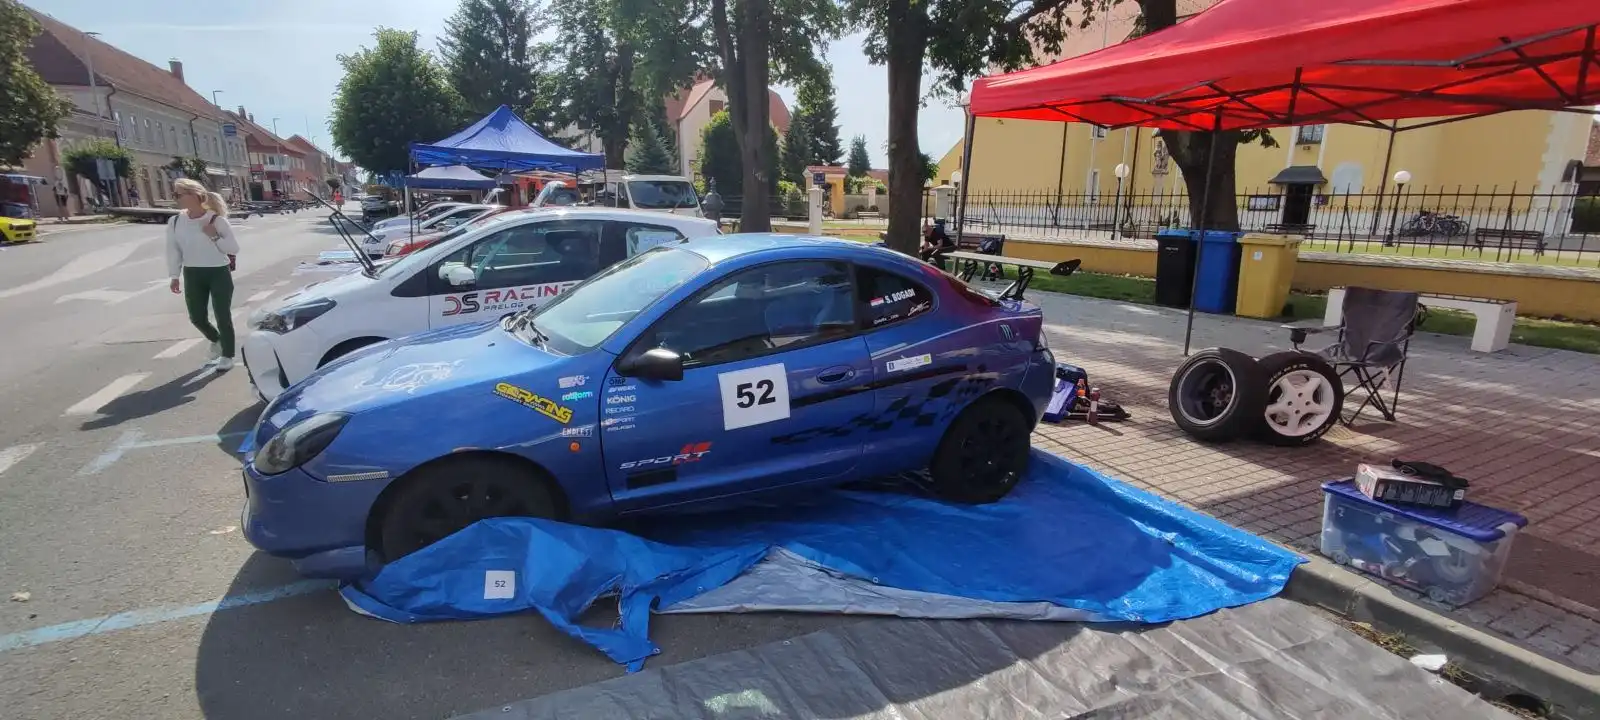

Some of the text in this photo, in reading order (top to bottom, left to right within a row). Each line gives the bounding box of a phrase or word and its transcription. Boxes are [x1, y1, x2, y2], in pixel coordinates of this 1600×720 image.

[892, 288, 915, 302] BOGADI
[483, 302, 524, 312] PRELOG
[606, 394, 636, 404] KÖNIG
[736, 379, 776, 409] 52
[605, 406, 635, 414] RECARO
[620, 450, 711, 470] SPORT
[494, 580, 506, 588] 52
